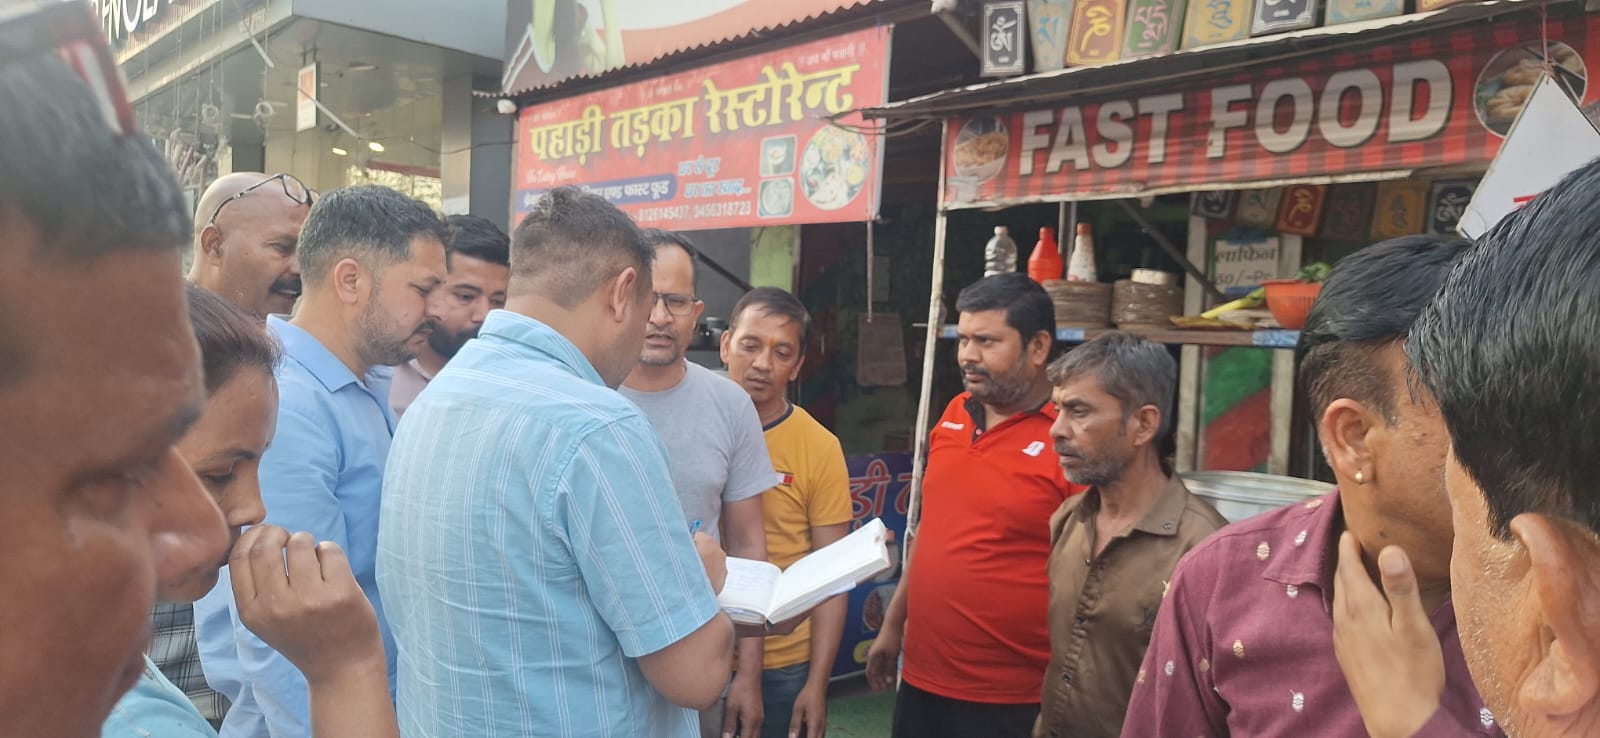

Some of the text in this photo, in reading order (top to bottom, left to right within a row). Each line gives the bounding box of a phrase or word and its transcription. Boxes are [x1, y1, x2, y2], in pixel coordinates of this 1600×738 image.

[529, 61, 861, 166] पहाड़ी तड़का रेस्टोरेन्ट
[1019, 59, 1453, 177] FAST FOOD
[650, 180, 670, 200] फूड
